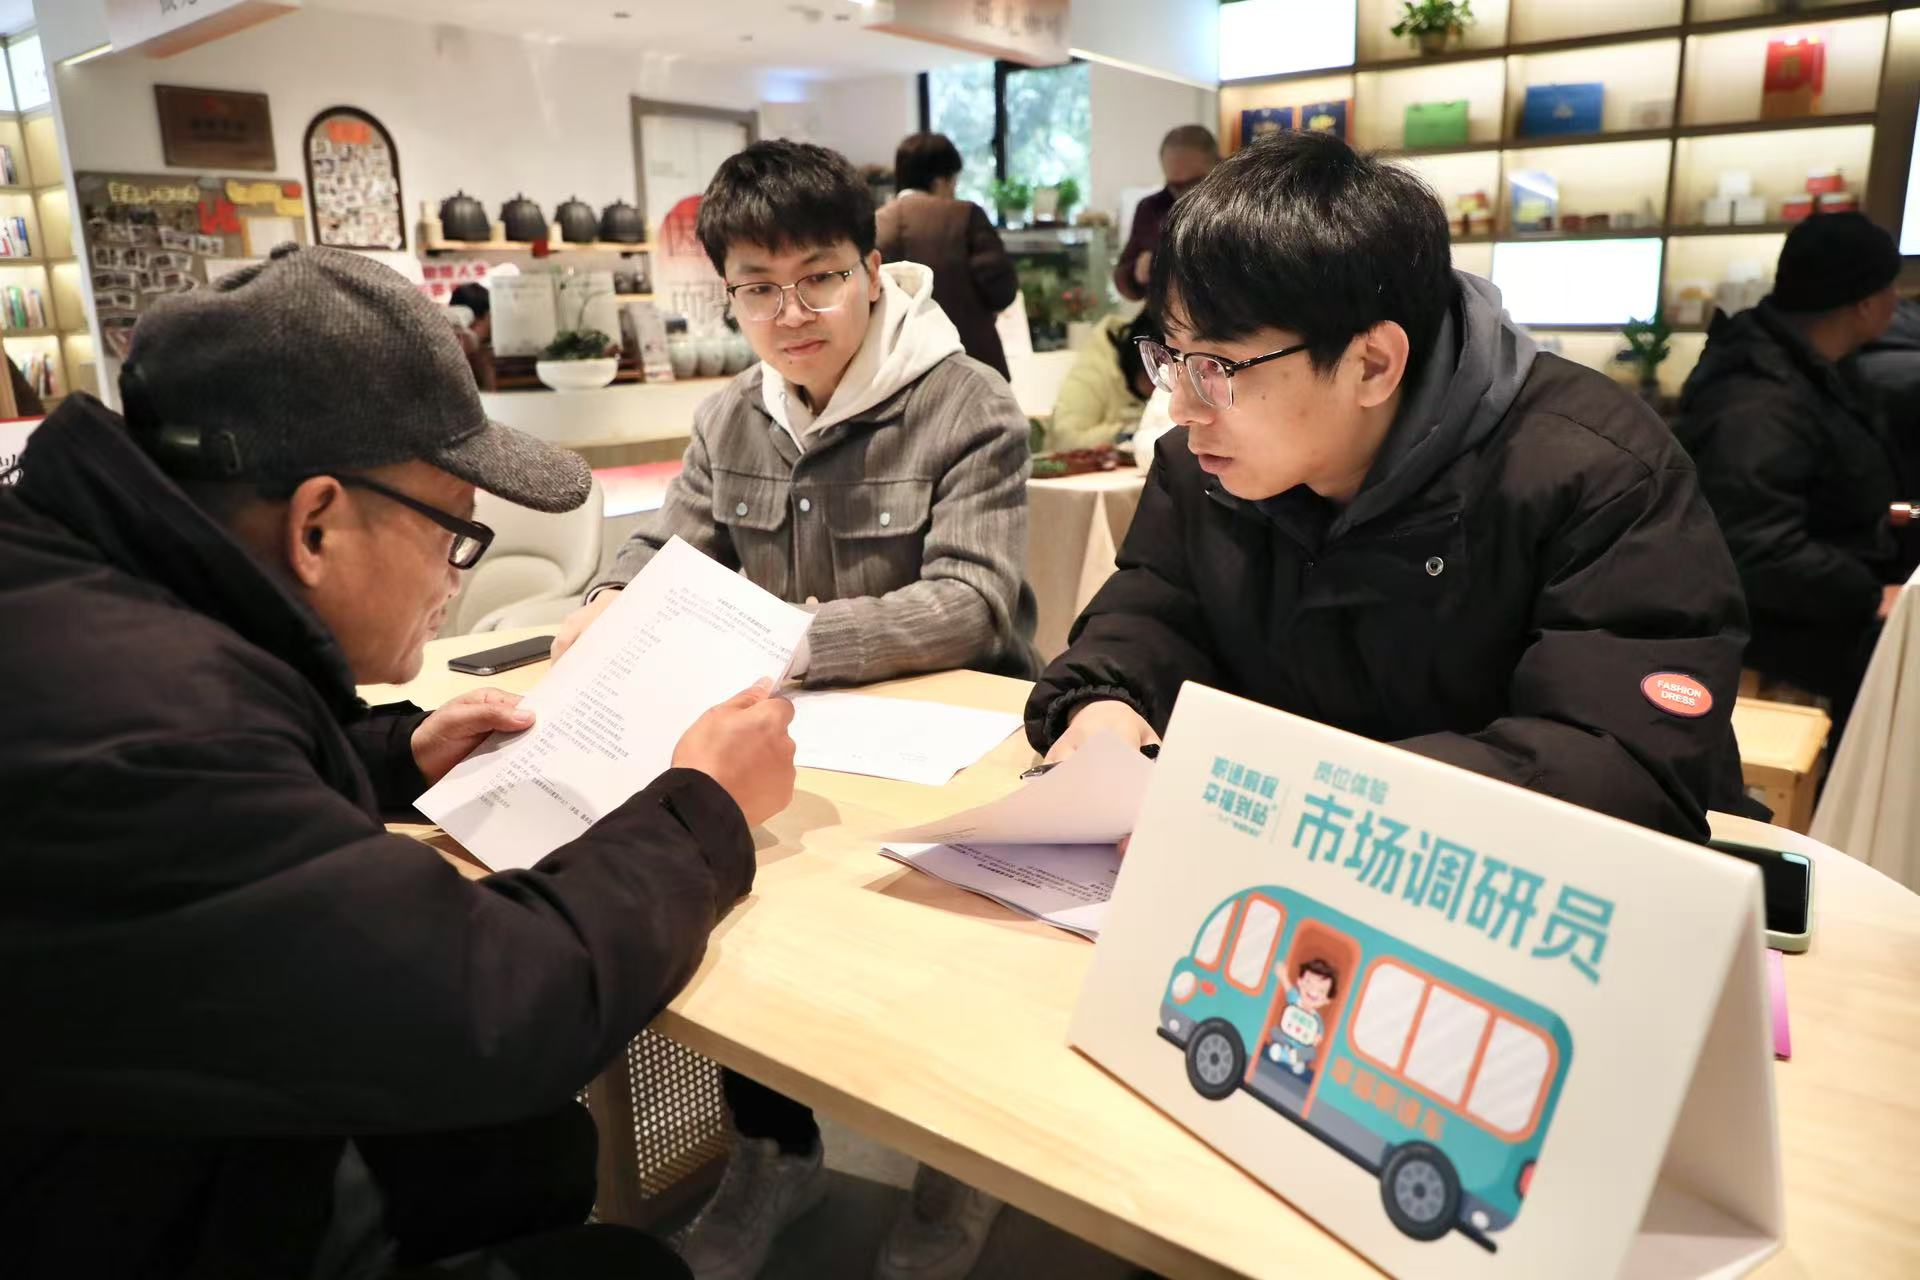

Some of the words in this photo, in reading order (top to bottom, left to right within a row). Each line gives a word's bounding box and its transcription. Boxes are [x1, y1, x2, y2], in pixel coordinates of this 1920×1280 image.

[1657, 680, 1701, 697] FASHION
[1661, 691, 1696, 707] DRESS
[1203, 782, 1269, 826] 幸福到站
[1313, 761, 1389, 805] 岗位体验
[1292, 793, 1616, 985] 市场调研员
